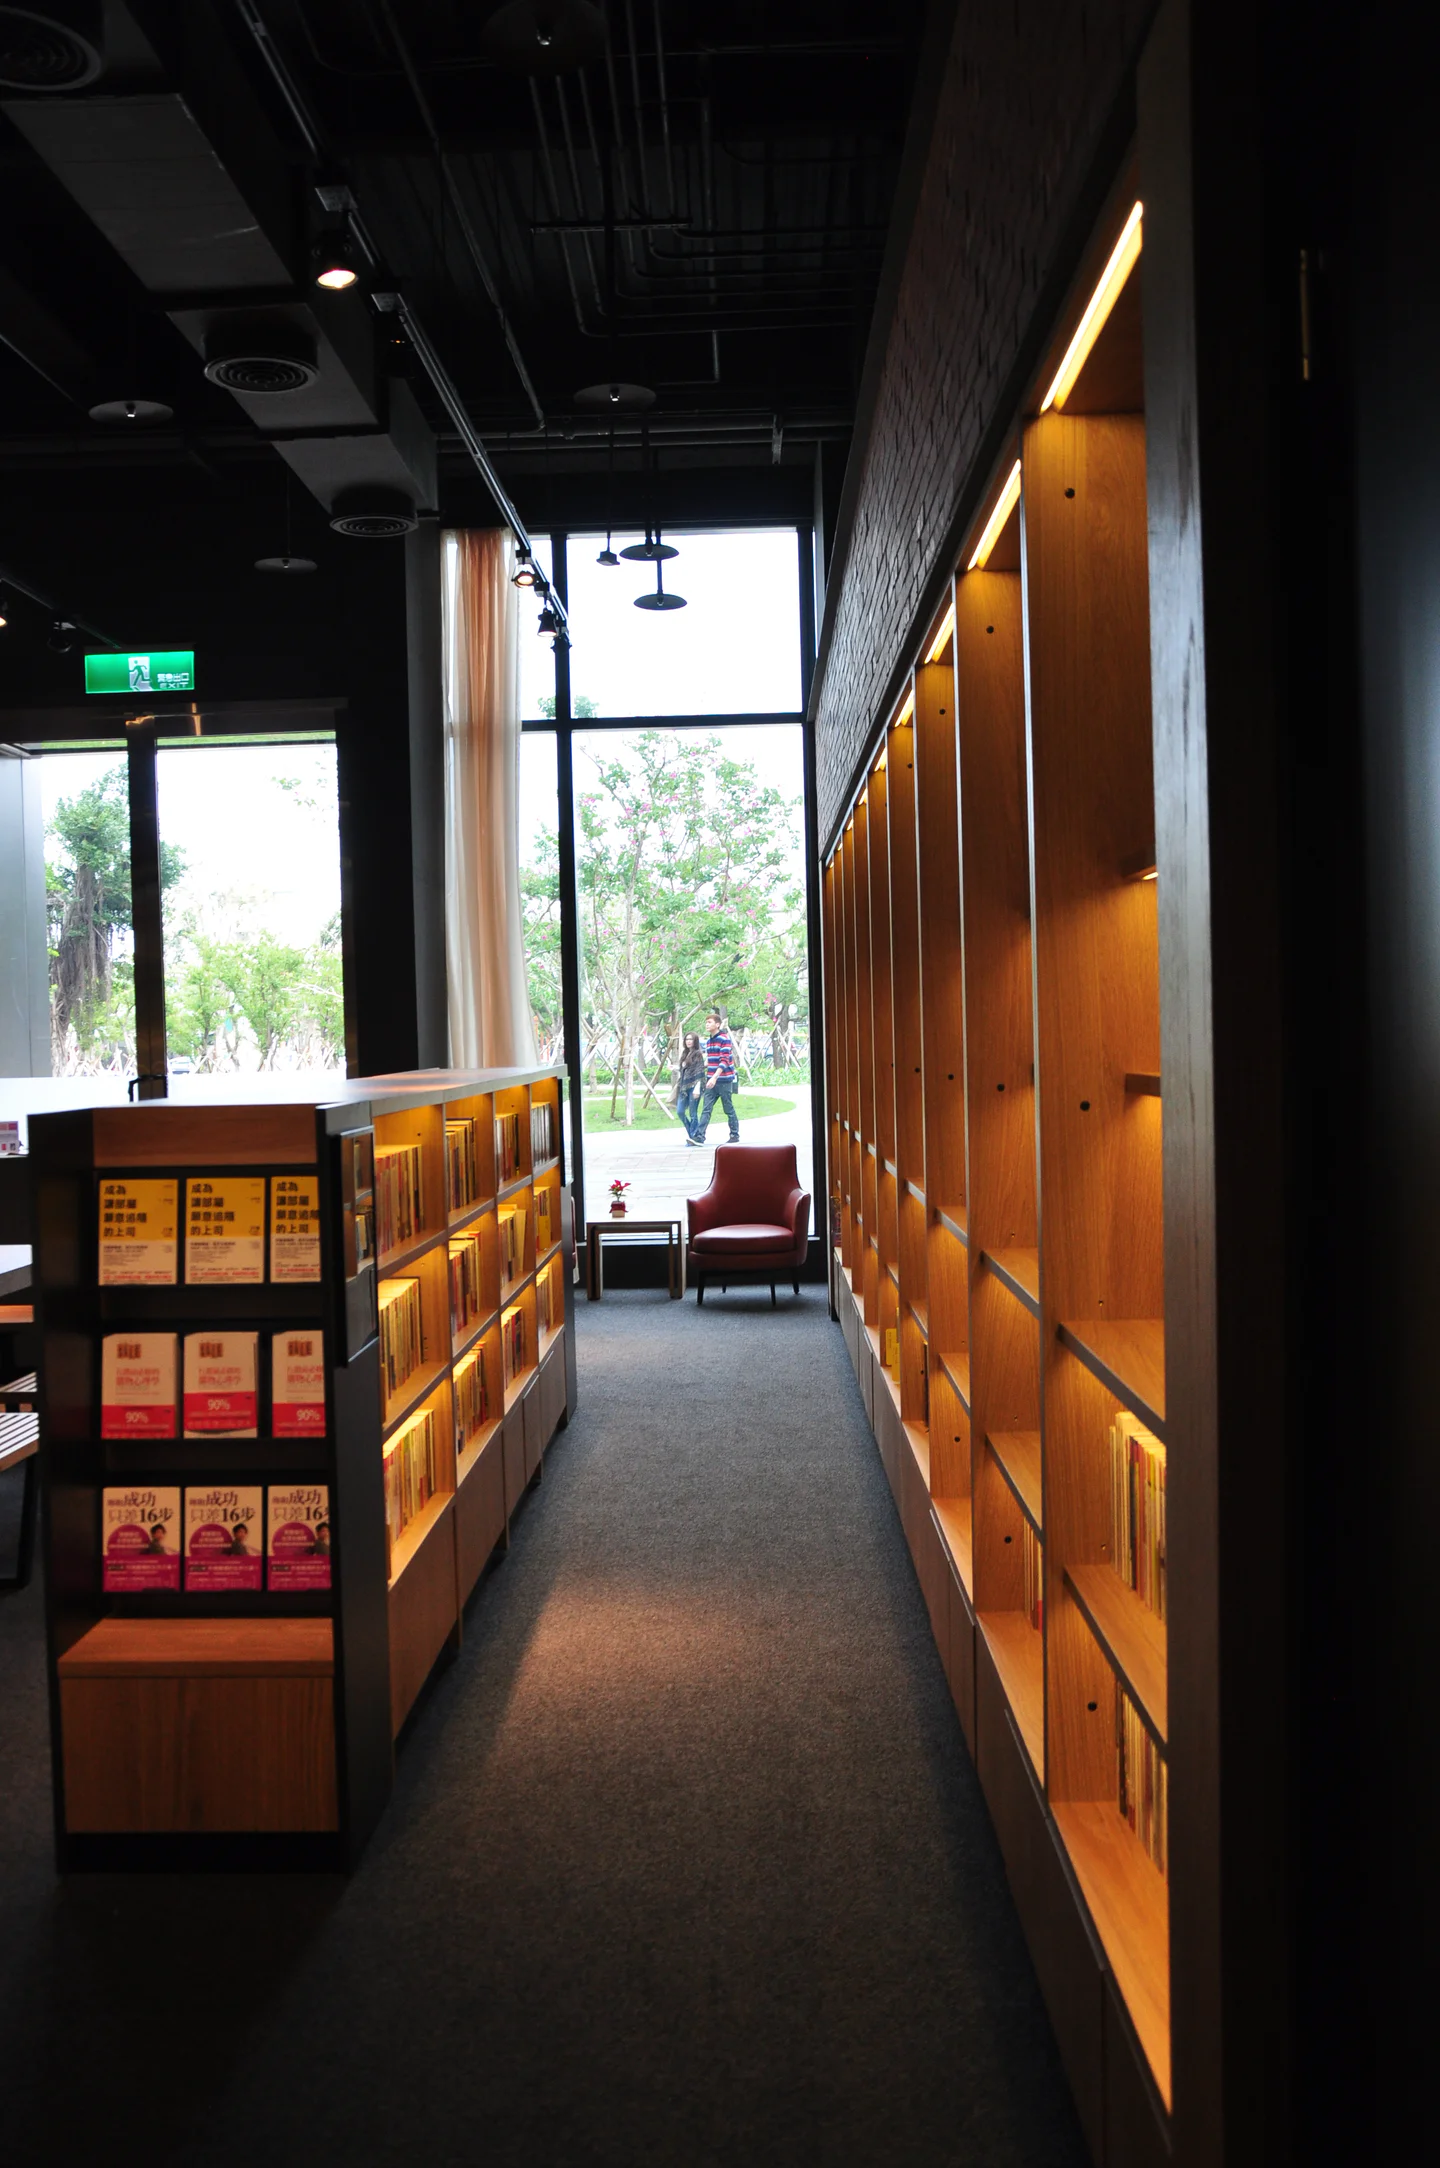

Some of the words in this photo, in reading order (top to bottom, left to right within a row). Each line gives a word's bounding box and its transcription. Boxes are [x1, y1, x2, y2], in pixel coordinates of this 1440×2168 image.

[104, 1185, 126, 1195] 成為
[191, 1183, 213, 1193] 成為
[276, 1181, 299, 1192] 成為
[104, 1226, 136, 1237] 的上司
[190, 1225, 224, 1236] 的上司
[276, 1224, 309, 1234] 的上司
[207, 1399, 230, 1411] 90%
[125, 1411, 149, 1423] 90%
[296, 1409, 321, 1421] 90%
[124, 1491, 156, 1507] 成功
[206, 1490, 238, 1506] 成功
[289, 1489, 321, 1505] 成功
